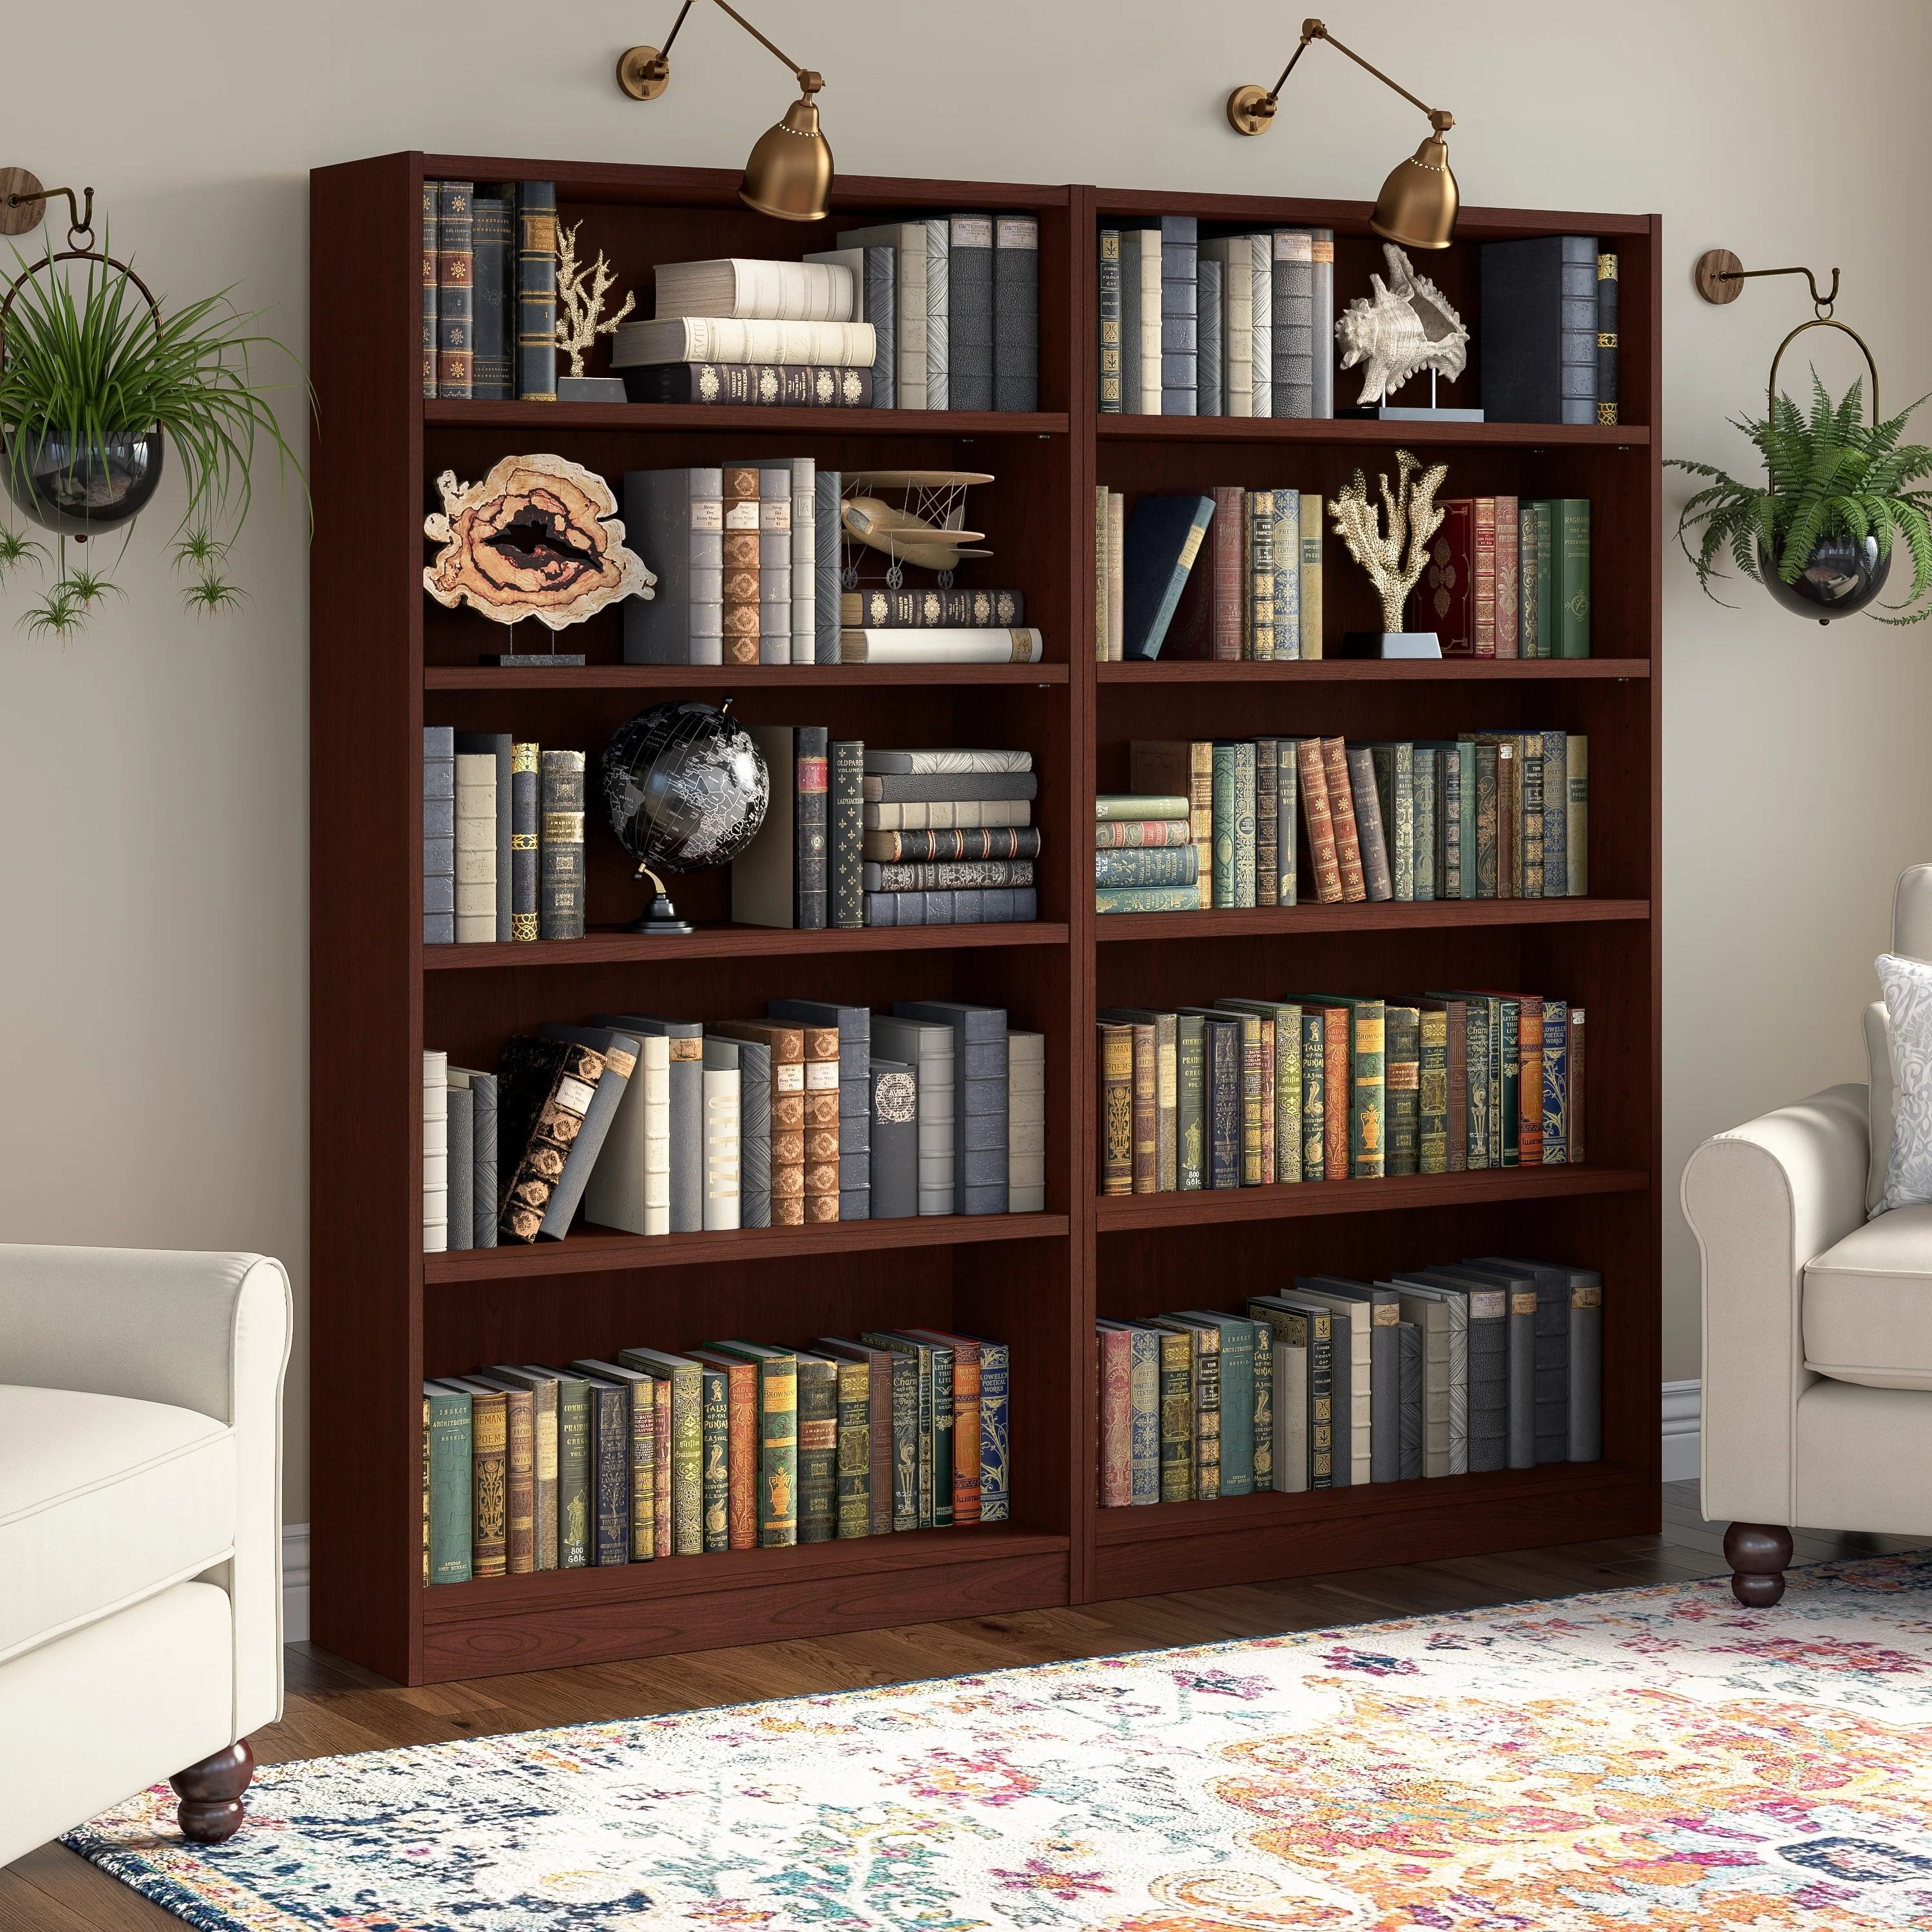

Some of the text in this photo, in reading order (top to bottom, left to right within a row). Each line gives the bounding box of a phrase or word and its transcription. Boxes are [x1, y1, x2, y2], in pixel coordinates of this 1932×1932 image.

[648, 735, 667, 743] ATLANTIC
[1102, 806, 1108, 815] PS
[1102, 857, 1108, 872] PR
[1104, 1045, 1132, 1054] HEMANS
[1303, 1043, 1323, 1052] TALES
[1105, 1063, 1132, 1072] POEMS
[877, 1076, 893, 1101] PARIS
[895, 1097, 902, 1106] 14
[708, 1095, 738, 1198] UFFIZI
[894, 1378, 918, 1387] Charm
[899, 1397, 914, 1406] Plays
[439, 1407, 467, 1416] INSECT
[705, 1403, 726, 1412] TALES
[474, 1414, 506, 1425] HEMANS
[474, 1434, 506, 1445] POEMS
